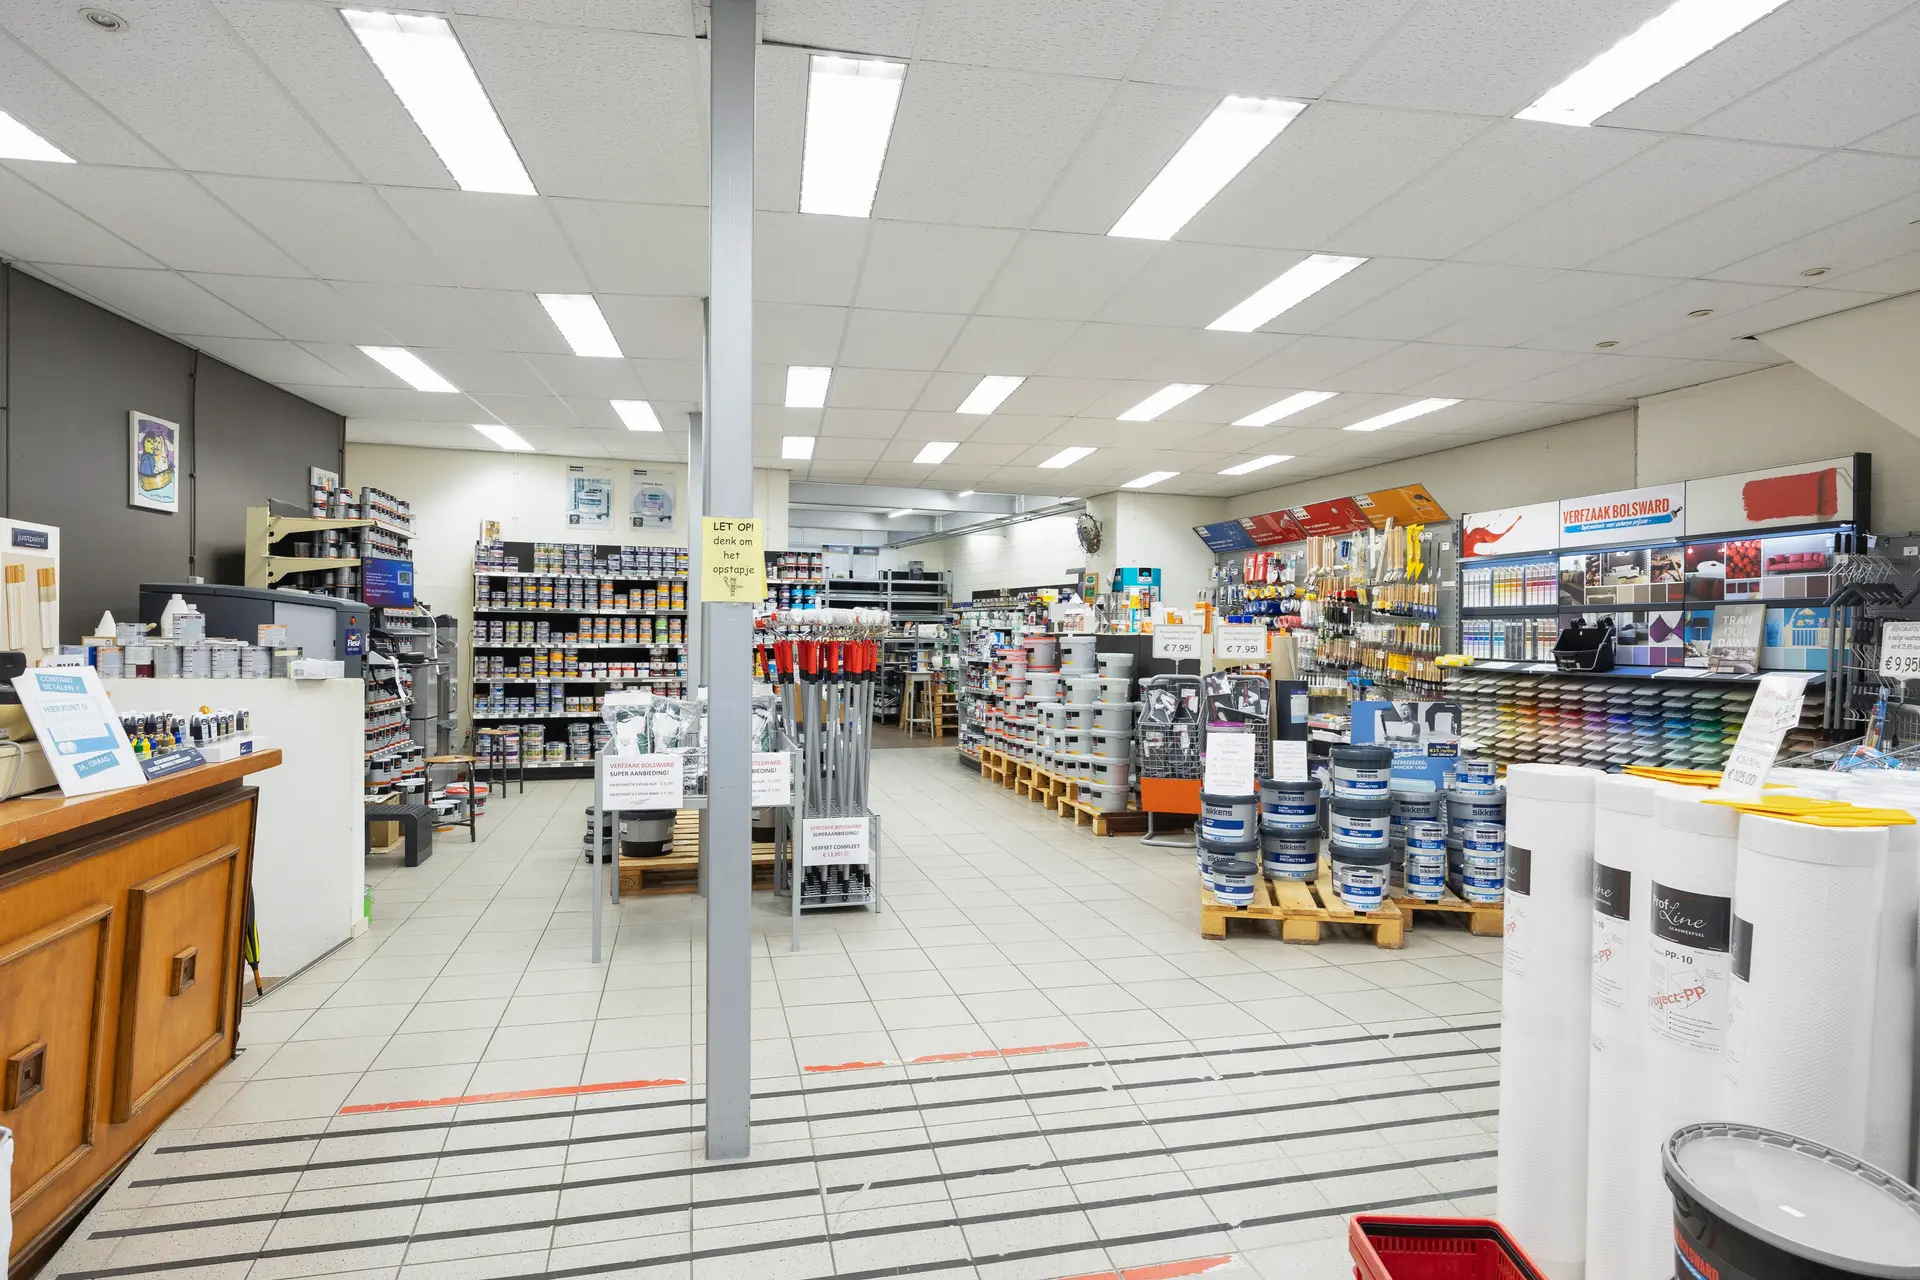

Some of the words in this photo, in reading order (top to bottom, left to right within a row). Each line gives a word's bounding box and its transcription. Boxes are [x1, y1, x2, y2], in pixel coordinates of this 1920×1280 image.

[1562, 506, 1610, 524] VERFZAAK
[1612, 498, 1670, 518] BOLSWARD
[713, 522, 734, 532] LET
[737, 522, 754, 532] OP!
[17, 532, 45, 544] justpaint
[713, 536, 736, 546] denk
[724, 550, 740, 560] het
[712, 566, 755, 576] opstapje
[1722, 616, 1753, 625] TRAN
[1164, 644, 1169, 652] €
[1885, 656, 1892, 670] €
[40, 676, 72, 684] CONTANT
[43, 704, 60, 713] HIER
[62, 703, 80, 712] KUNT
[88, 754, 110, 768] GRAAG
[1206, 808, 1232, 816] sikkens
[1280, 843, 1306, 851] sikkens
[1505, 864, 1518, 876] ne
[1594, 882, 1614, 898] ine
[1652, 894, 1669, 911] Prof
[1659, 902, 1707, 929] Line
[1665, 950, 1693, 964] PP-10
